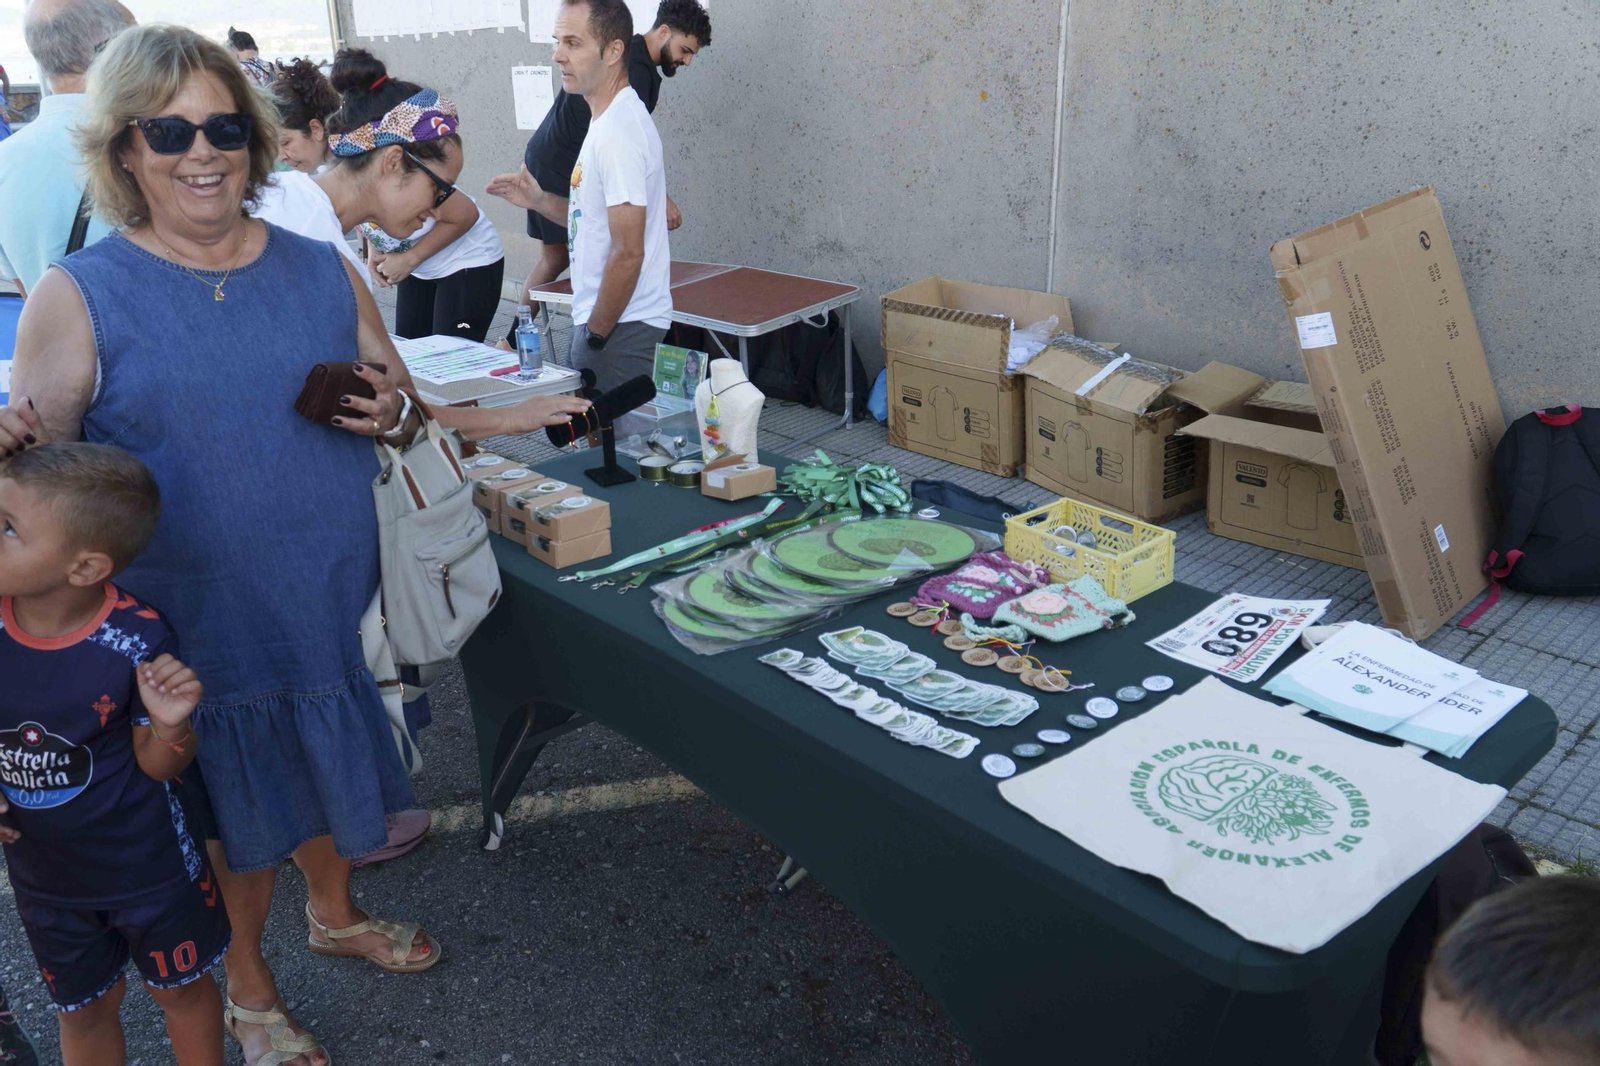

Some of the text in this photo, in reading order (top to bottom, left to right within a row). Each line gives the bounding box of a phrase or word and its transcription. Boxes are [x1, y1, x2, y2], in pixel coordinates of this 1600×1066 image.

[1375, 413, 1391, 454] SUPPLIER
[1379, 406, 1396, 451] PLATFORM
[1385, 407, 1401, 448] DELIVERY
[1458, 403, 1472, 437] BLANCA
[1468, 436, 1479, 460] MESA
[1238, 463, 1266, 476] VALENTO
[1432, 588, 1444, 616] ORDER
[1438, 569, 1453, 609] SUPPLIER
[1454, 583, 1463, 601] EAN
[1202, 612, 1274, 656] 680
[1287, 607, 1314, 626] 5KM
[1268, 628, 1294, 647] POR
[1332, 656, 1432, 699] ALEXANDER
[1349, 650, 1438, 690] LA ENFERMEDAD DE
[1471, 698, 1487, 706] DE
[0, 761, 70, 789] Galicia
[1129, 739, 1371, 868] ASOCIACIÓN ESPAÑOLA DE ENFERMOS DE ALEXANDER
[149, 940, 198, 978] 10
